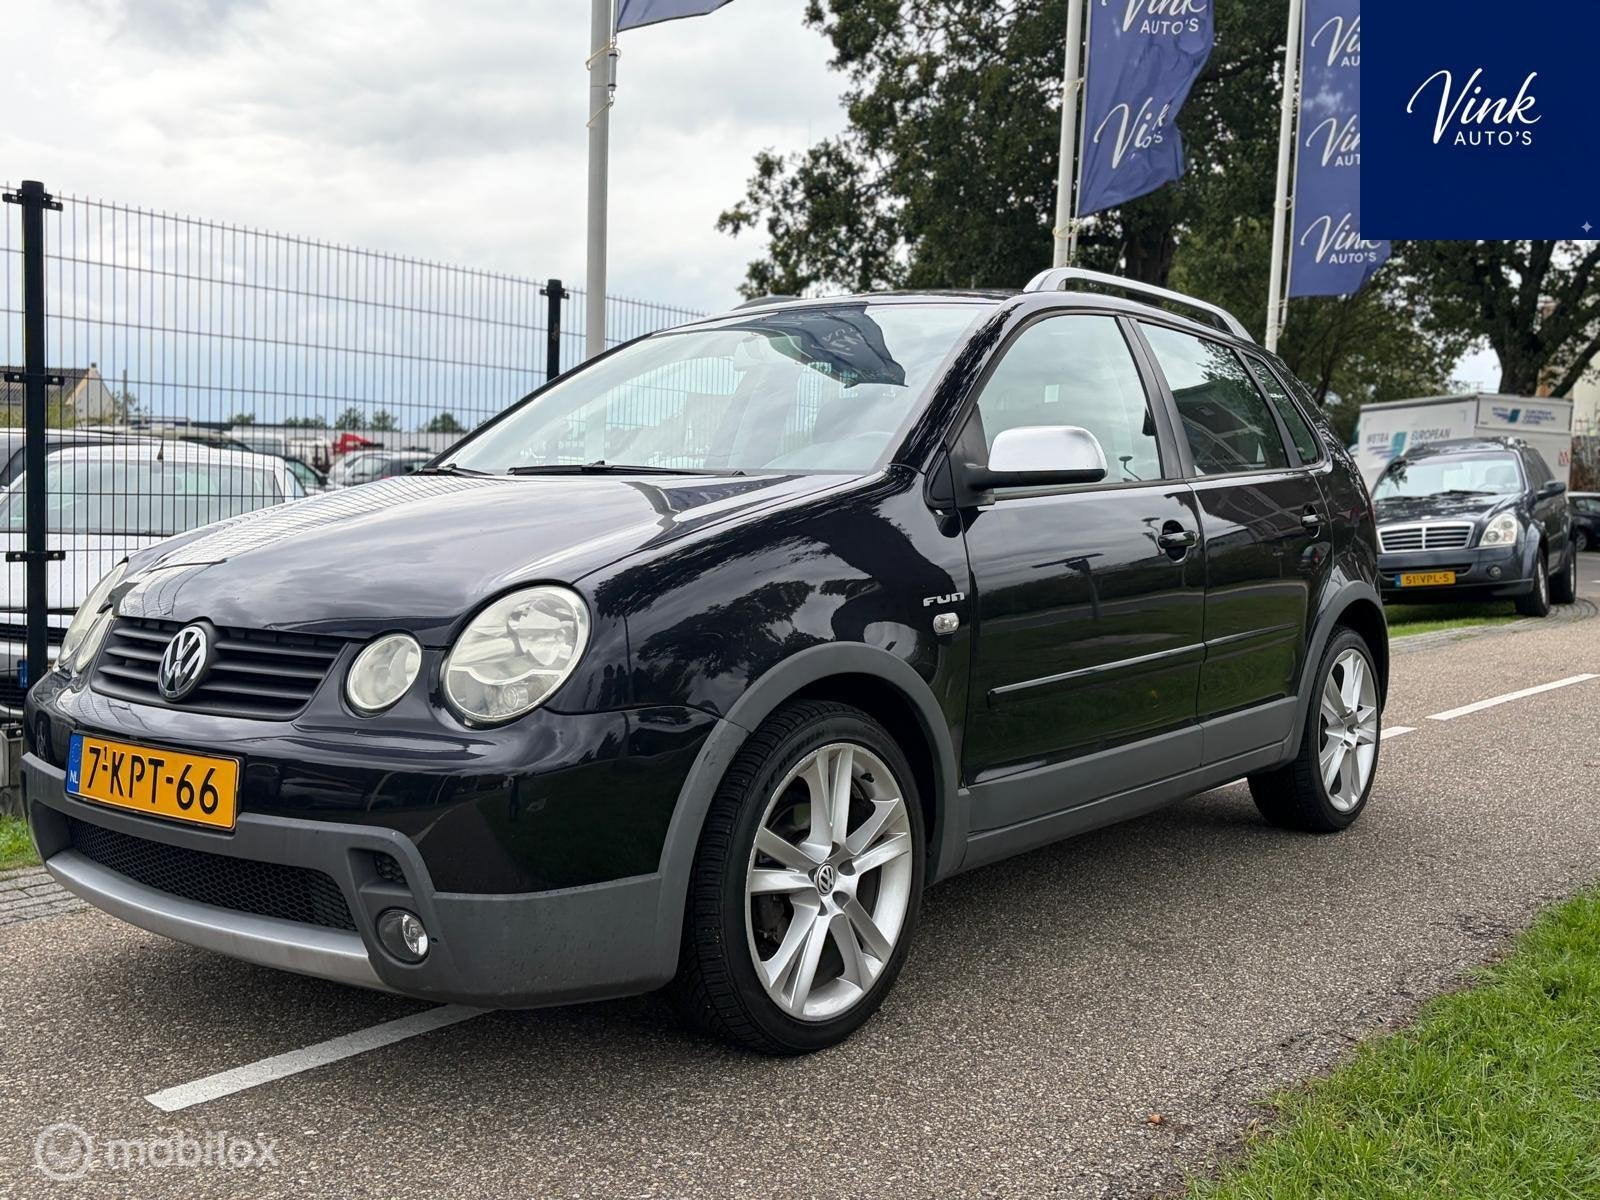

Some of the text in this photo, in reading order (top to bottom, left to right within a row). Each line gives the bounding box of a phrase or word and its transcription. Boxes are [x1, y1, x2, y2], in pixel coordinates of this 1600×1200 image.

[1140, 17, 1199, 35] AUTO'S
[1329, 252, 1377, 264] AUTO'S
[69, 769, 79, 784] NL
